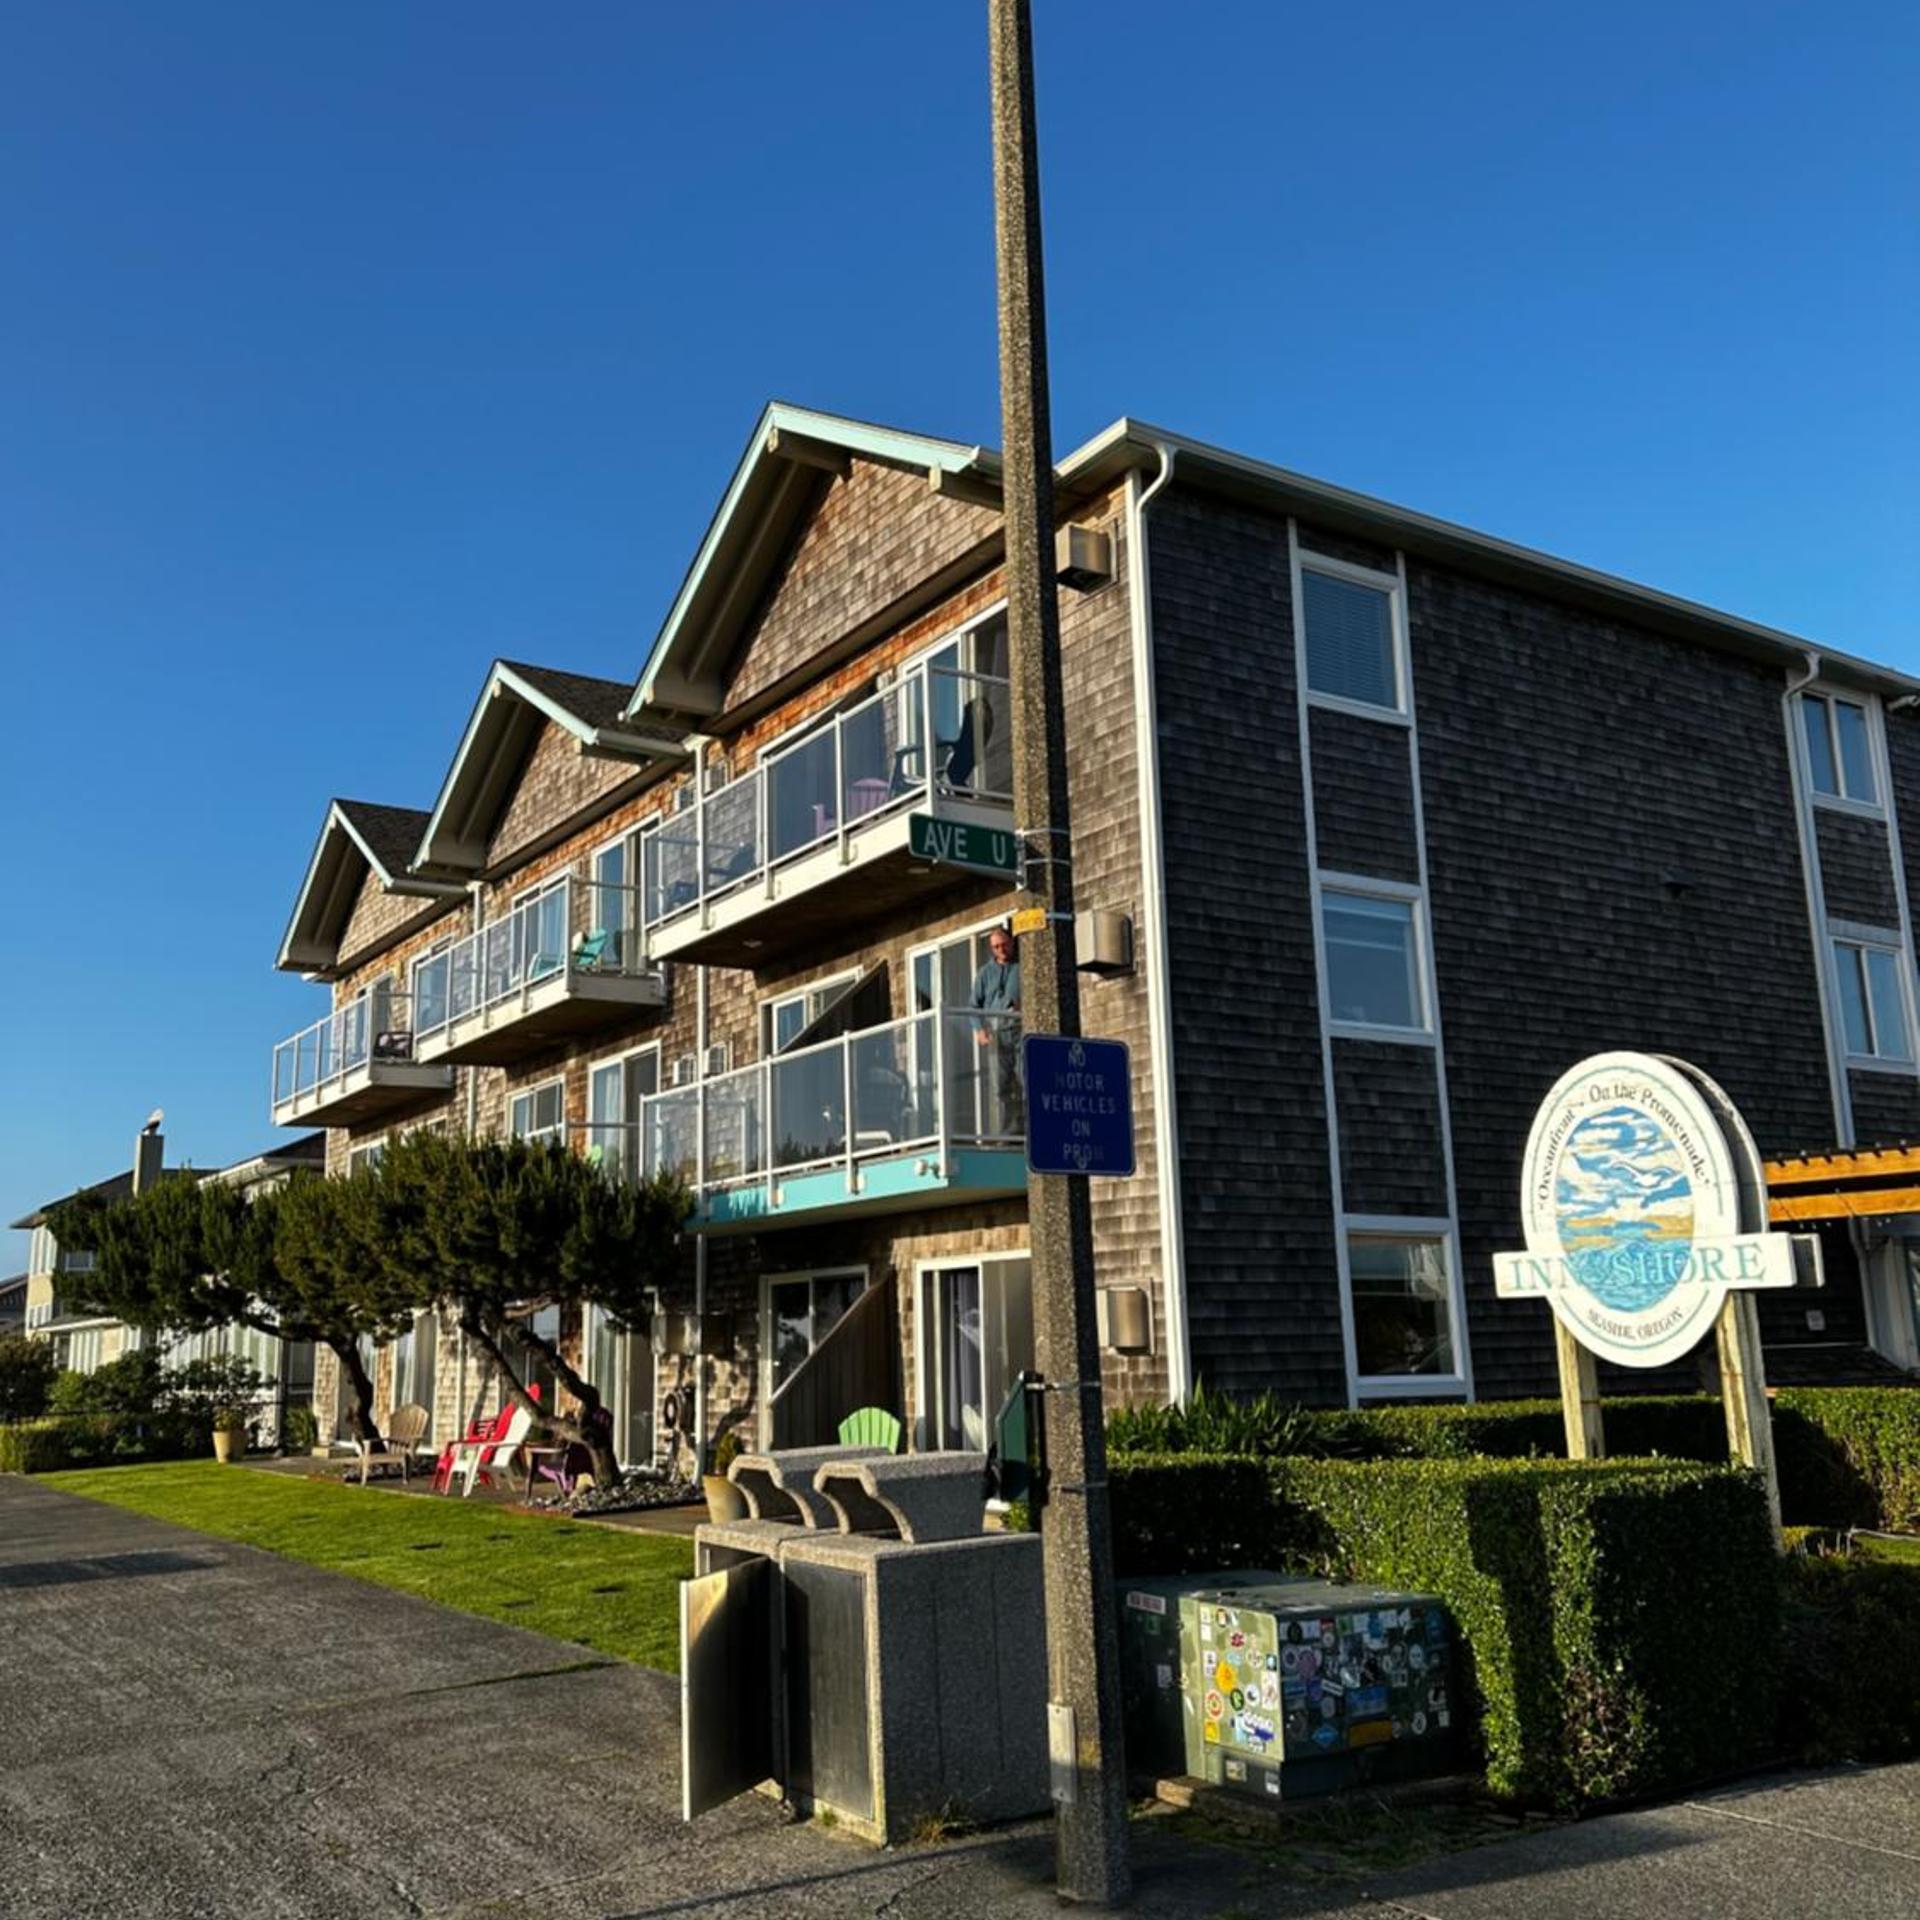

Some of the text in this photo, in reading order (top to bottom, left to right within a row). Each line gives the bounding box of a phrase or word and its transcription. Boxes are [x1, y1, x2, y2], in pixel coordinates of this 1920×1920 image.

[923, 822, 1007, 865] AVE U
[1067, 1047, 1087, 1068] NO
[1053, 1072, 1105, 1092] MOTOR
[1588, 1084, 1610, 1103] On
[1614, 1083, 1637, 1100] the
[1041, 1093, 1116, 1115] VEHICLES
[1071, 1117, 1091, 1137] ON
[1612, 1241, 1767, 1286] SHORE
